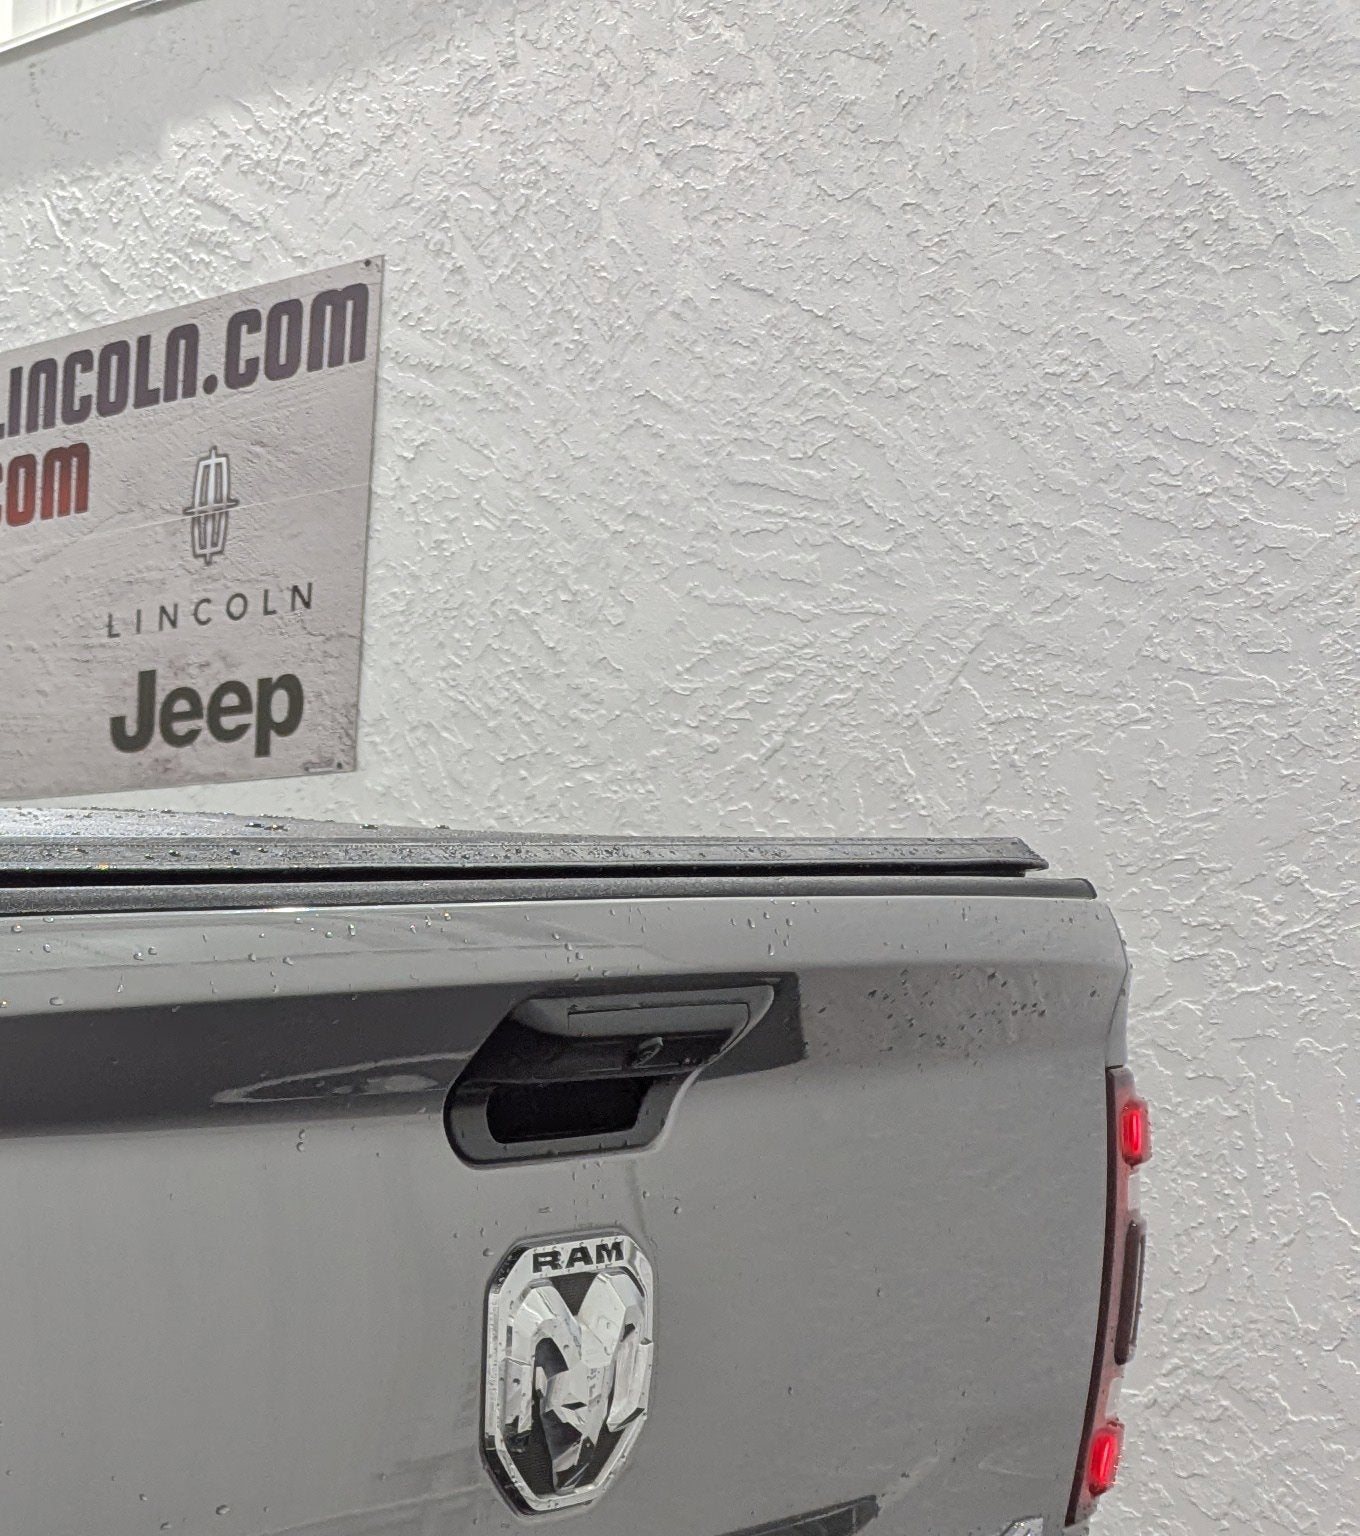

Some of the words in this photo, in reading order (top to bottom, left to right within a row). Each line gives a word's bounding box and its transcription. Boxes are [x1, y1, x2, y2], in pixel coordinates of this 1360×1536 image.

[106, 581, 314, 639] LINCOLN
[109, 668, 305, 758] Jeep
[531, 1238, 625, 1274] RAM
